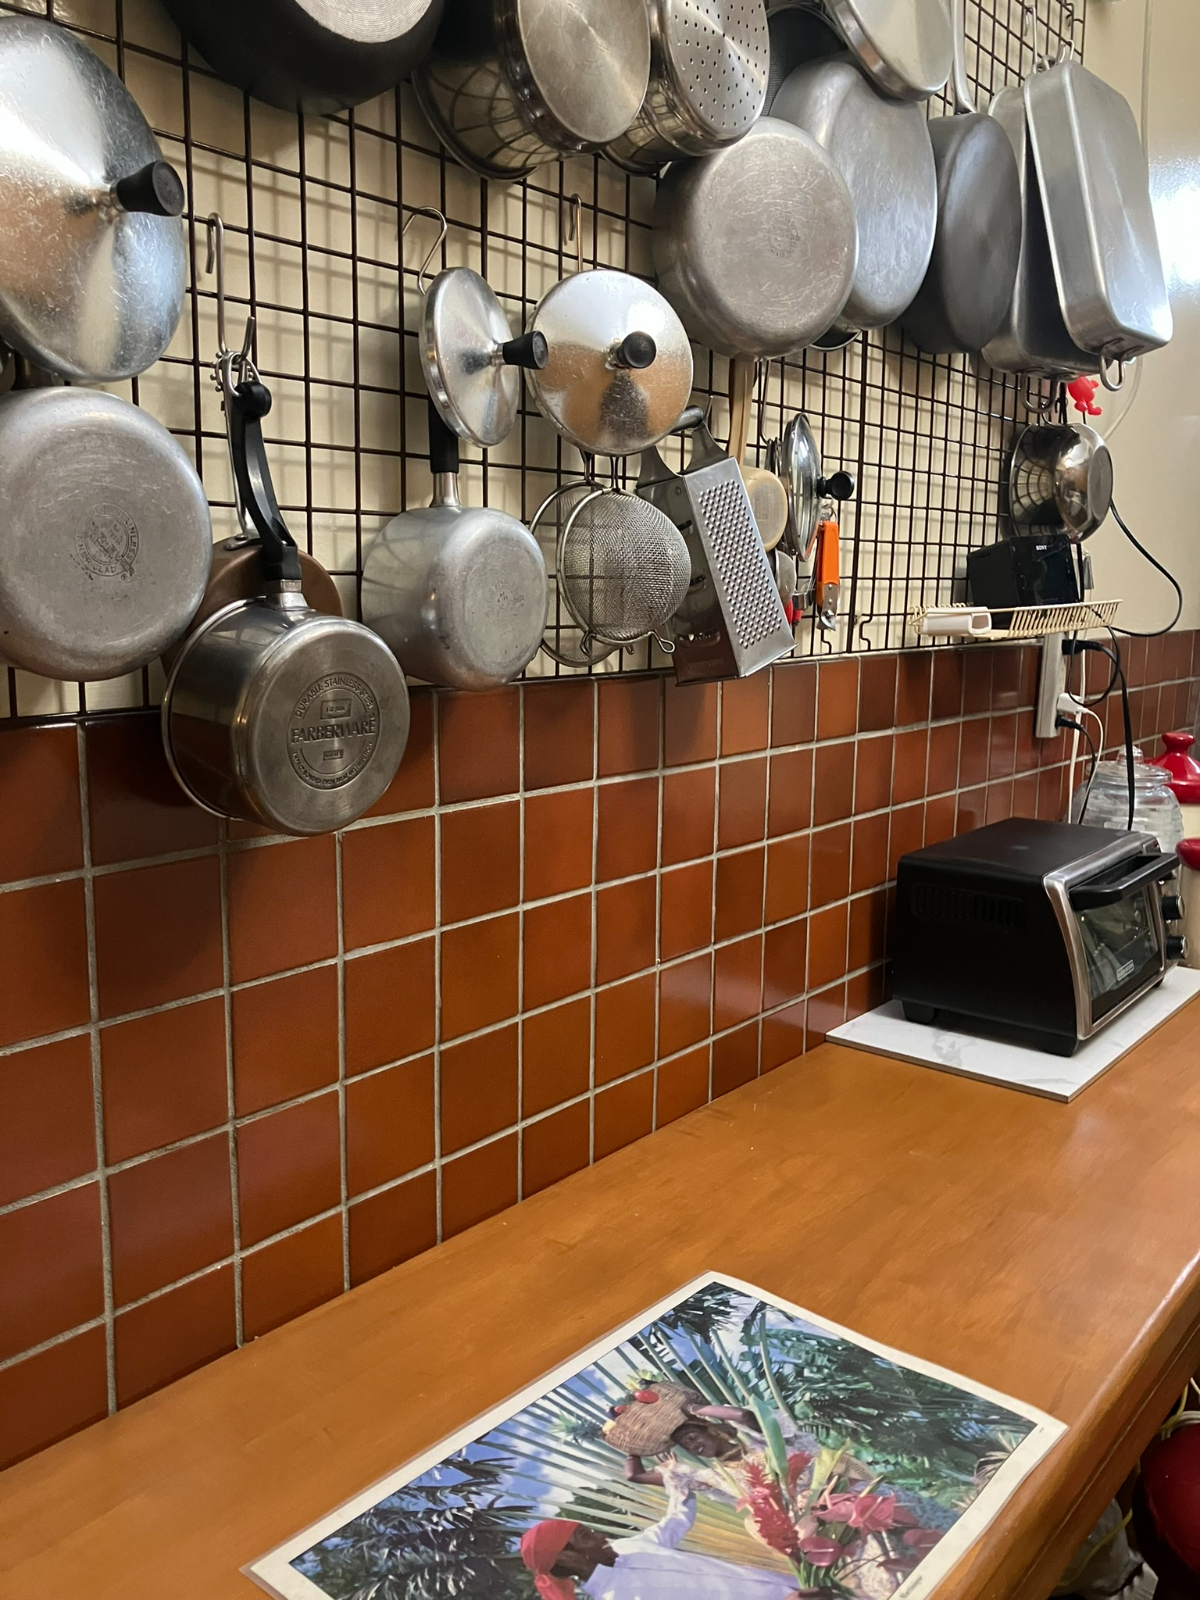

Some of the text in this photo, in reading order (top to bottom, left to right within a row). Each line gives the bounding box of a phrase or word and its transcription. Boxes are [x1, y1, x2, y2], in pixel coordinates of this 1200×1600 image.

[295, 684, 323, 719] DURABLE
[324, 677, 361, 692] STAINLESS
[291, 719, 376, 744] FARBERWARE
